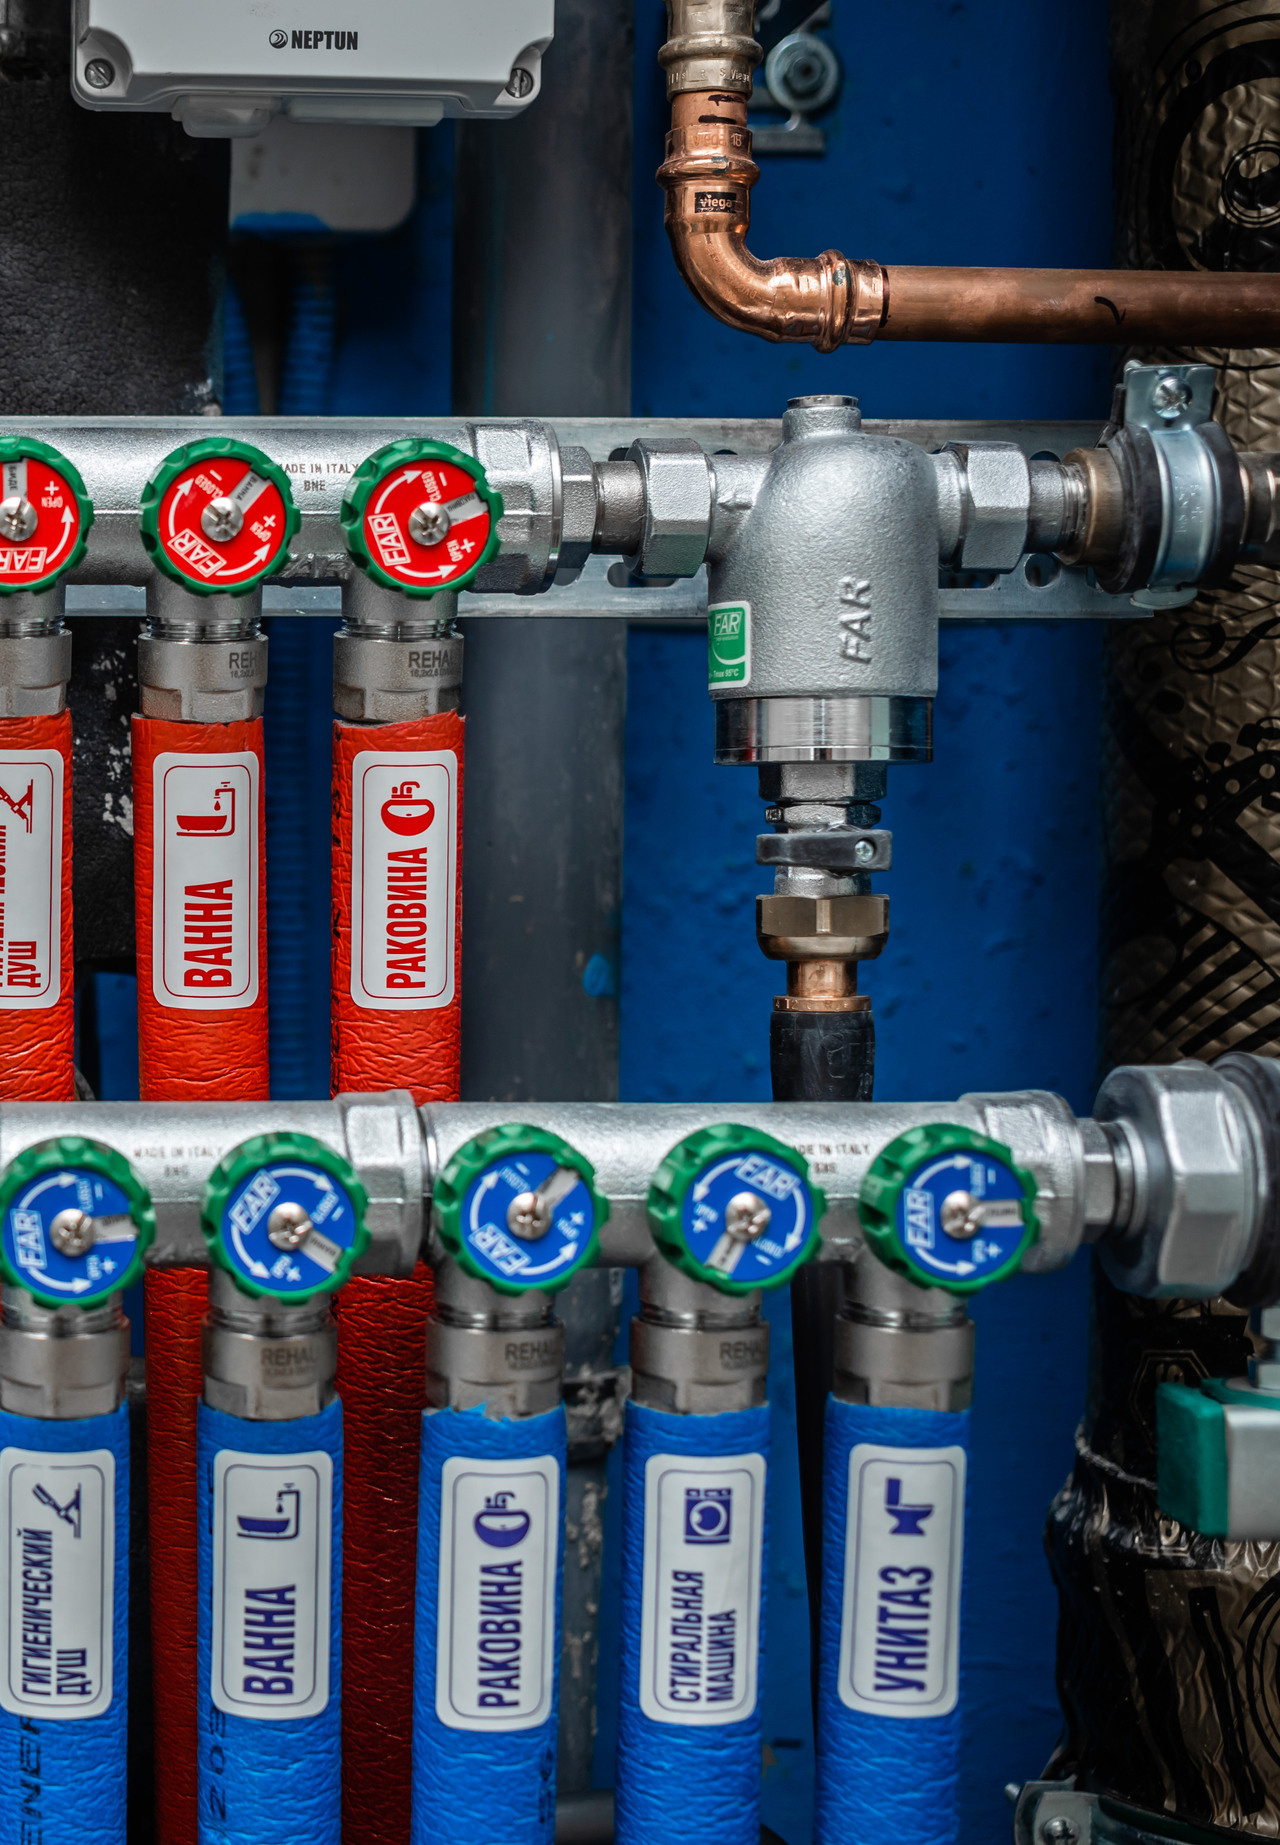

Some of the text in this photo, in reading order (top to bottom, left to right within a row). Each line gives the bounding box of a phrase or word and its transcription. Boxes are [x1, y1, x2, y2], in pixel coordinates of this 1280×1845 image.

[291, 29, 359, 51] NEPTUN
[700, 193, 733, 210] viega
[194, 473, 224, 500] CLOSED
[310, 463, 323, 475] IN
[420, 470, 442, 503] CLOSED
[41, 495, 64, 509] OPEN
[170, 531, 225, 575] FAR
[249, 520, 272, 543] OPEN
[370, 513, 410, 566] FAR
[445, 538, 464, 563] OPEN
[714, 613, 742, 635] FAR
[839, 574, 873, 665] FAR
[183, 879, 233, 988] ВАННА
[385, 846, 428, 989] РАКОВИНА
[7, 940, 42, 988] ДУШ
[229, 1171, 280, 1234] FAR
[735, 1154, 800, 1201] FAR
[12, 1209, 47, 1269] FAR
[905, 1188, 935, 1249] FAR
[468, 1224, 530, 1275] FAR
[16, 1527, 54, 1697] ГИГИЕНИЧЕСКИЙ
[478, 1559, 524, 1708] РАКОВИНА
[669, 1569, 704, 1703] СТИРАЛЬНАЯ
[873, 1565, 934, 1692] УНИТАЗ
[242, 1584, 297, 1696] ВАННА
[706, 1609, 737, 1702] МАШИНА
[56, 1648, 92, 1696] ДУШ
